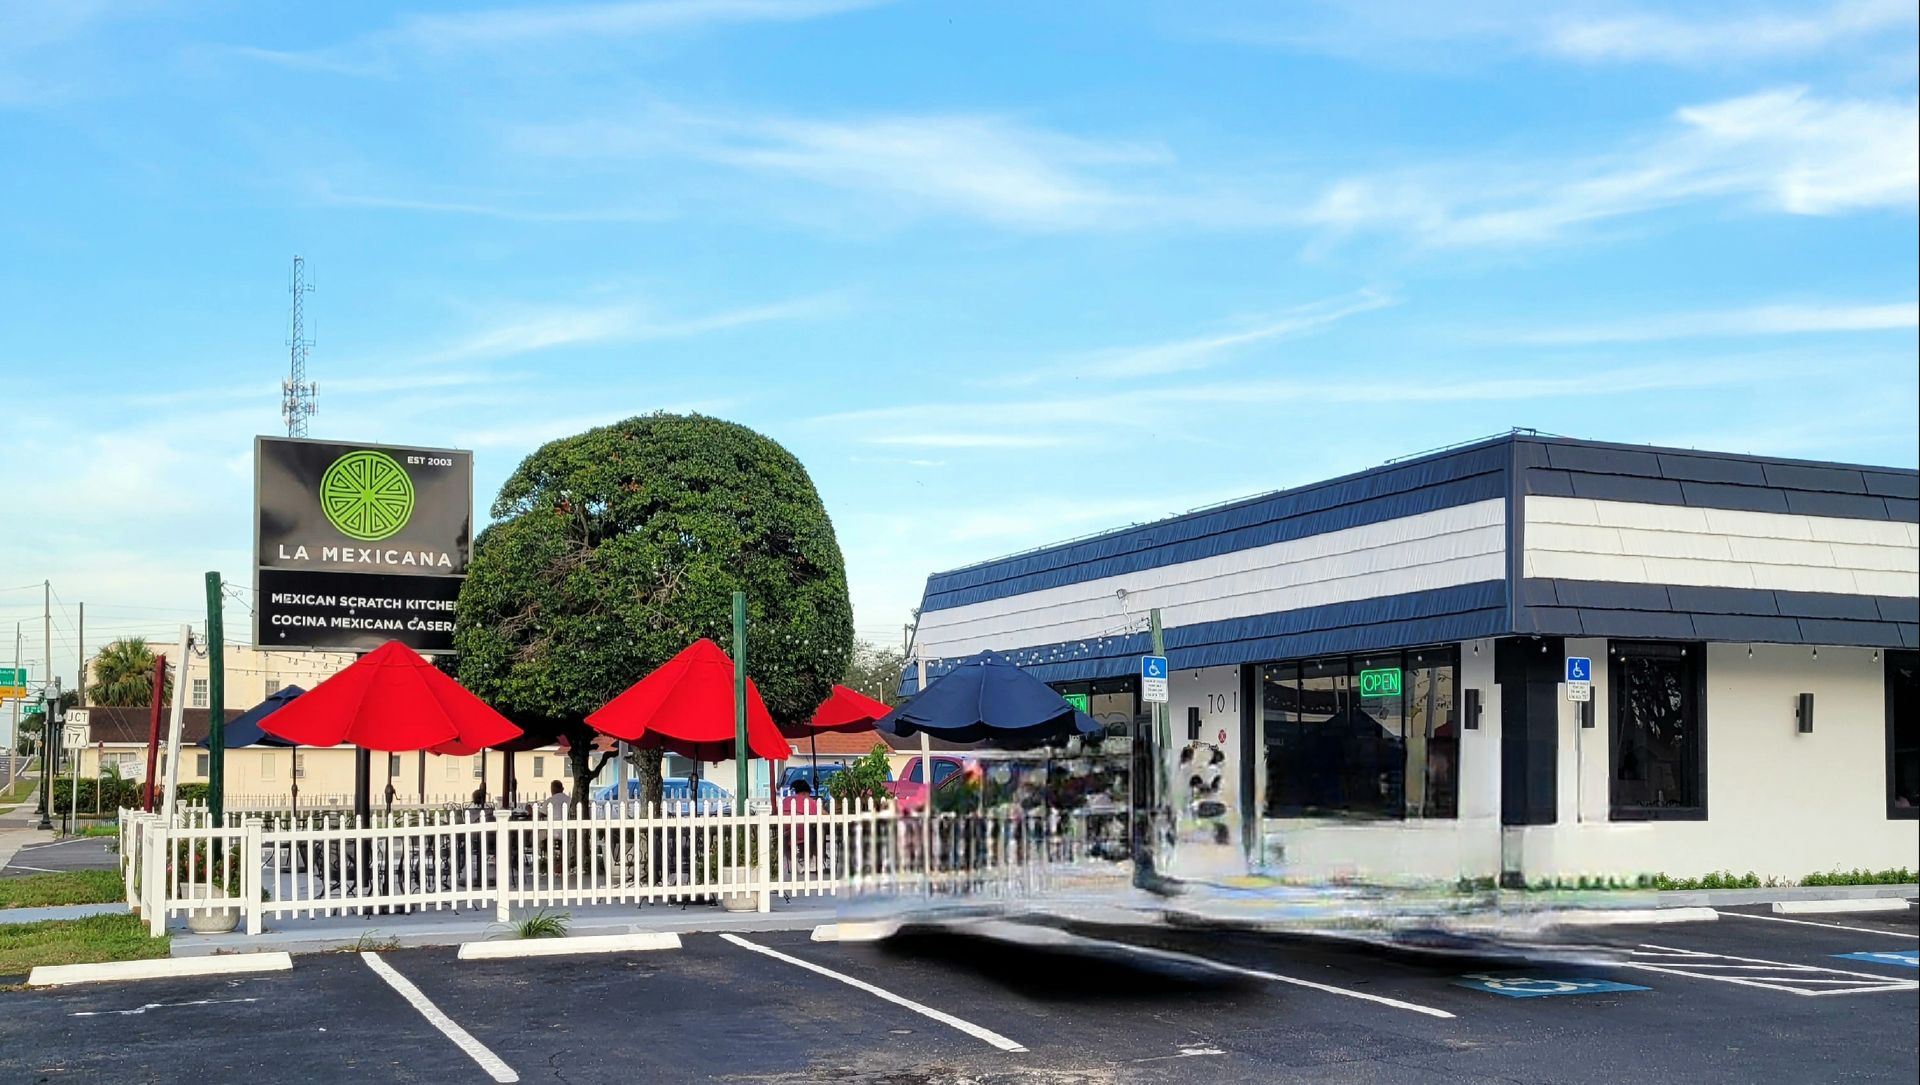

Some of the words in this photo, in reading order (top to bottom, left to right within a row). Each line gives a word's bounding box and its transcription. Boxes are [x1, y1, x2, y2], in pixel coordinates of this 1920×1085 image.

[408, 456, 425, 465] EST
[428, 458, 452, 467] 2003
[279, 544, 309, 560] LA
[322, 547, 452, 567] MEXICANA
[271, 593, 336, 606] MEXICAN
[340, 596, 402, 609] SCRATCH
[406, 599, 457, 611] KITCHE
[271, 615, 327, 628] COCINA
[331, 617, 403, 630] MEXICANA
[1364, 673, 1397, 691] OPEN
[68, 712, 87, 722] JCT
[68, 733, 81, 744] 17
